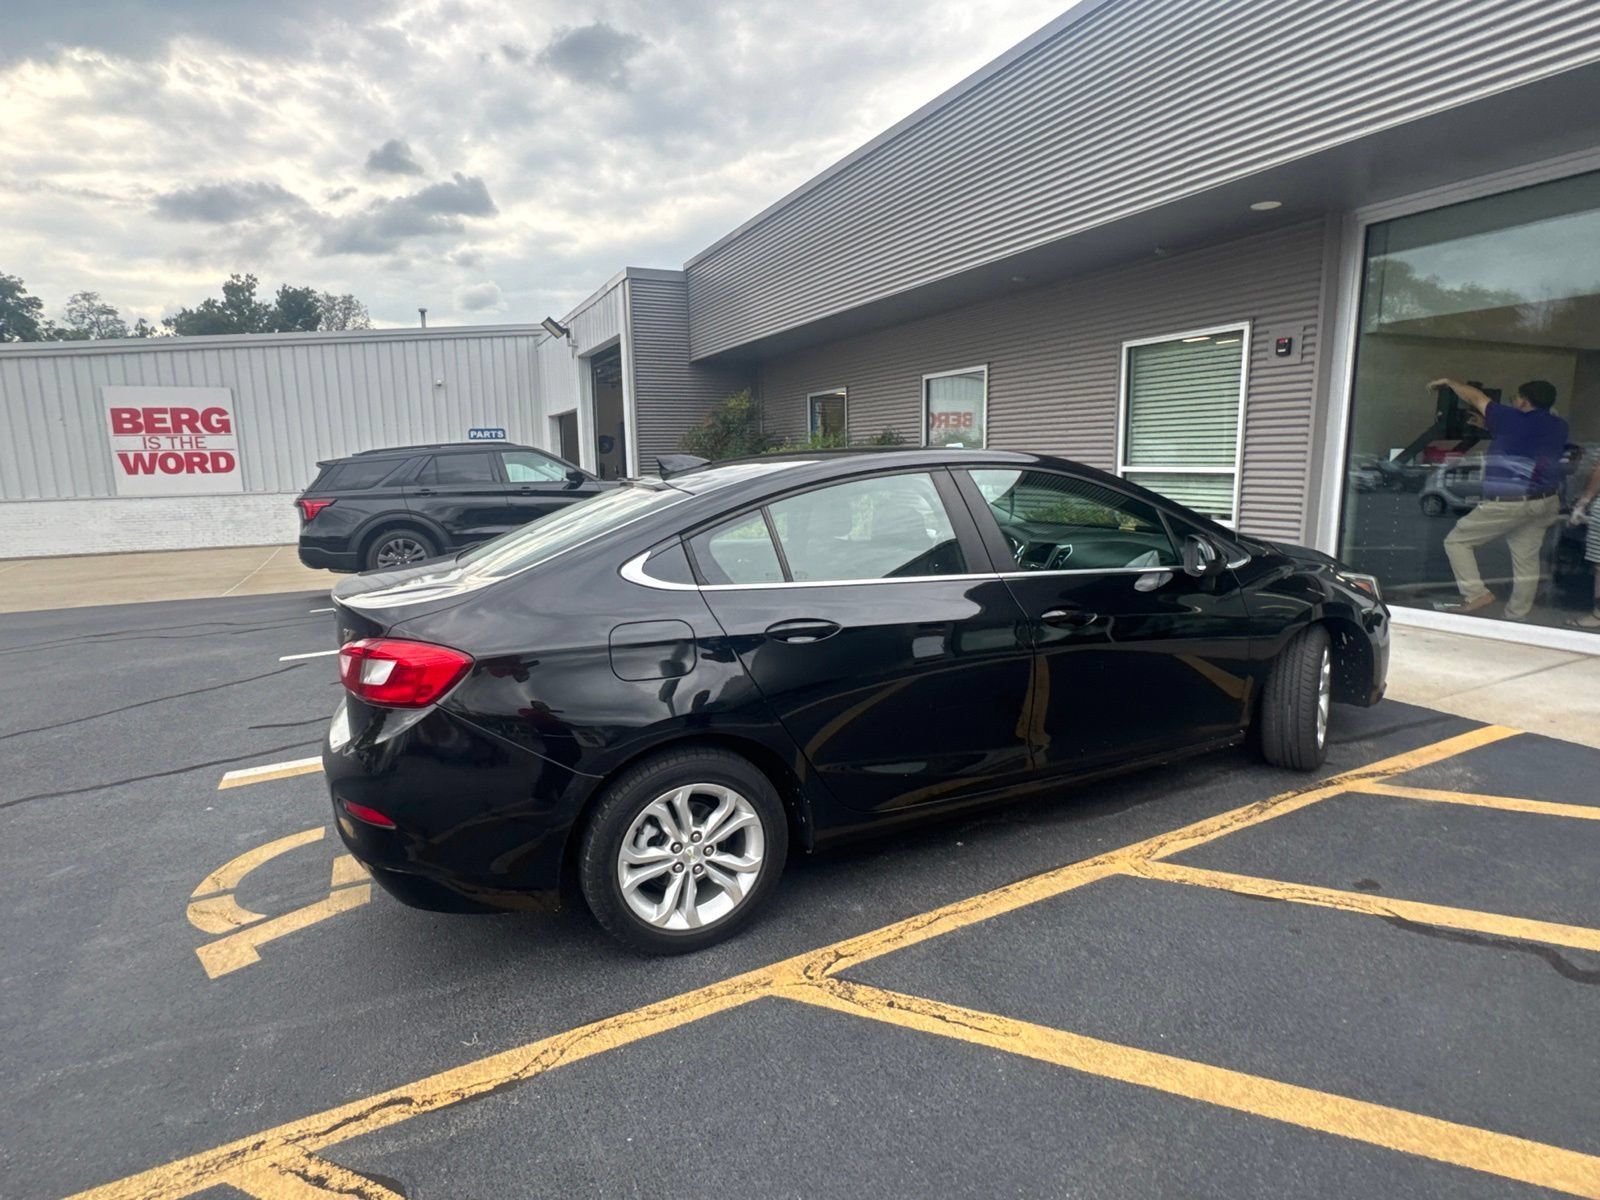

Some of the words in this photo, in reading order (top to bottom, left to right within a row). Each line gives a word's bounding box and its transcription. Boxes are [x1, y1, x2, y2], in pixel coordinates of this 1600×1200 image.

[110, 407, 231, 434] BERG
[142, 436, 161, 449] IS
[165, 436, 207, 449] THE
[470, 430, 504, 438] PARTS
[117, 452, 235, 475] WORD
